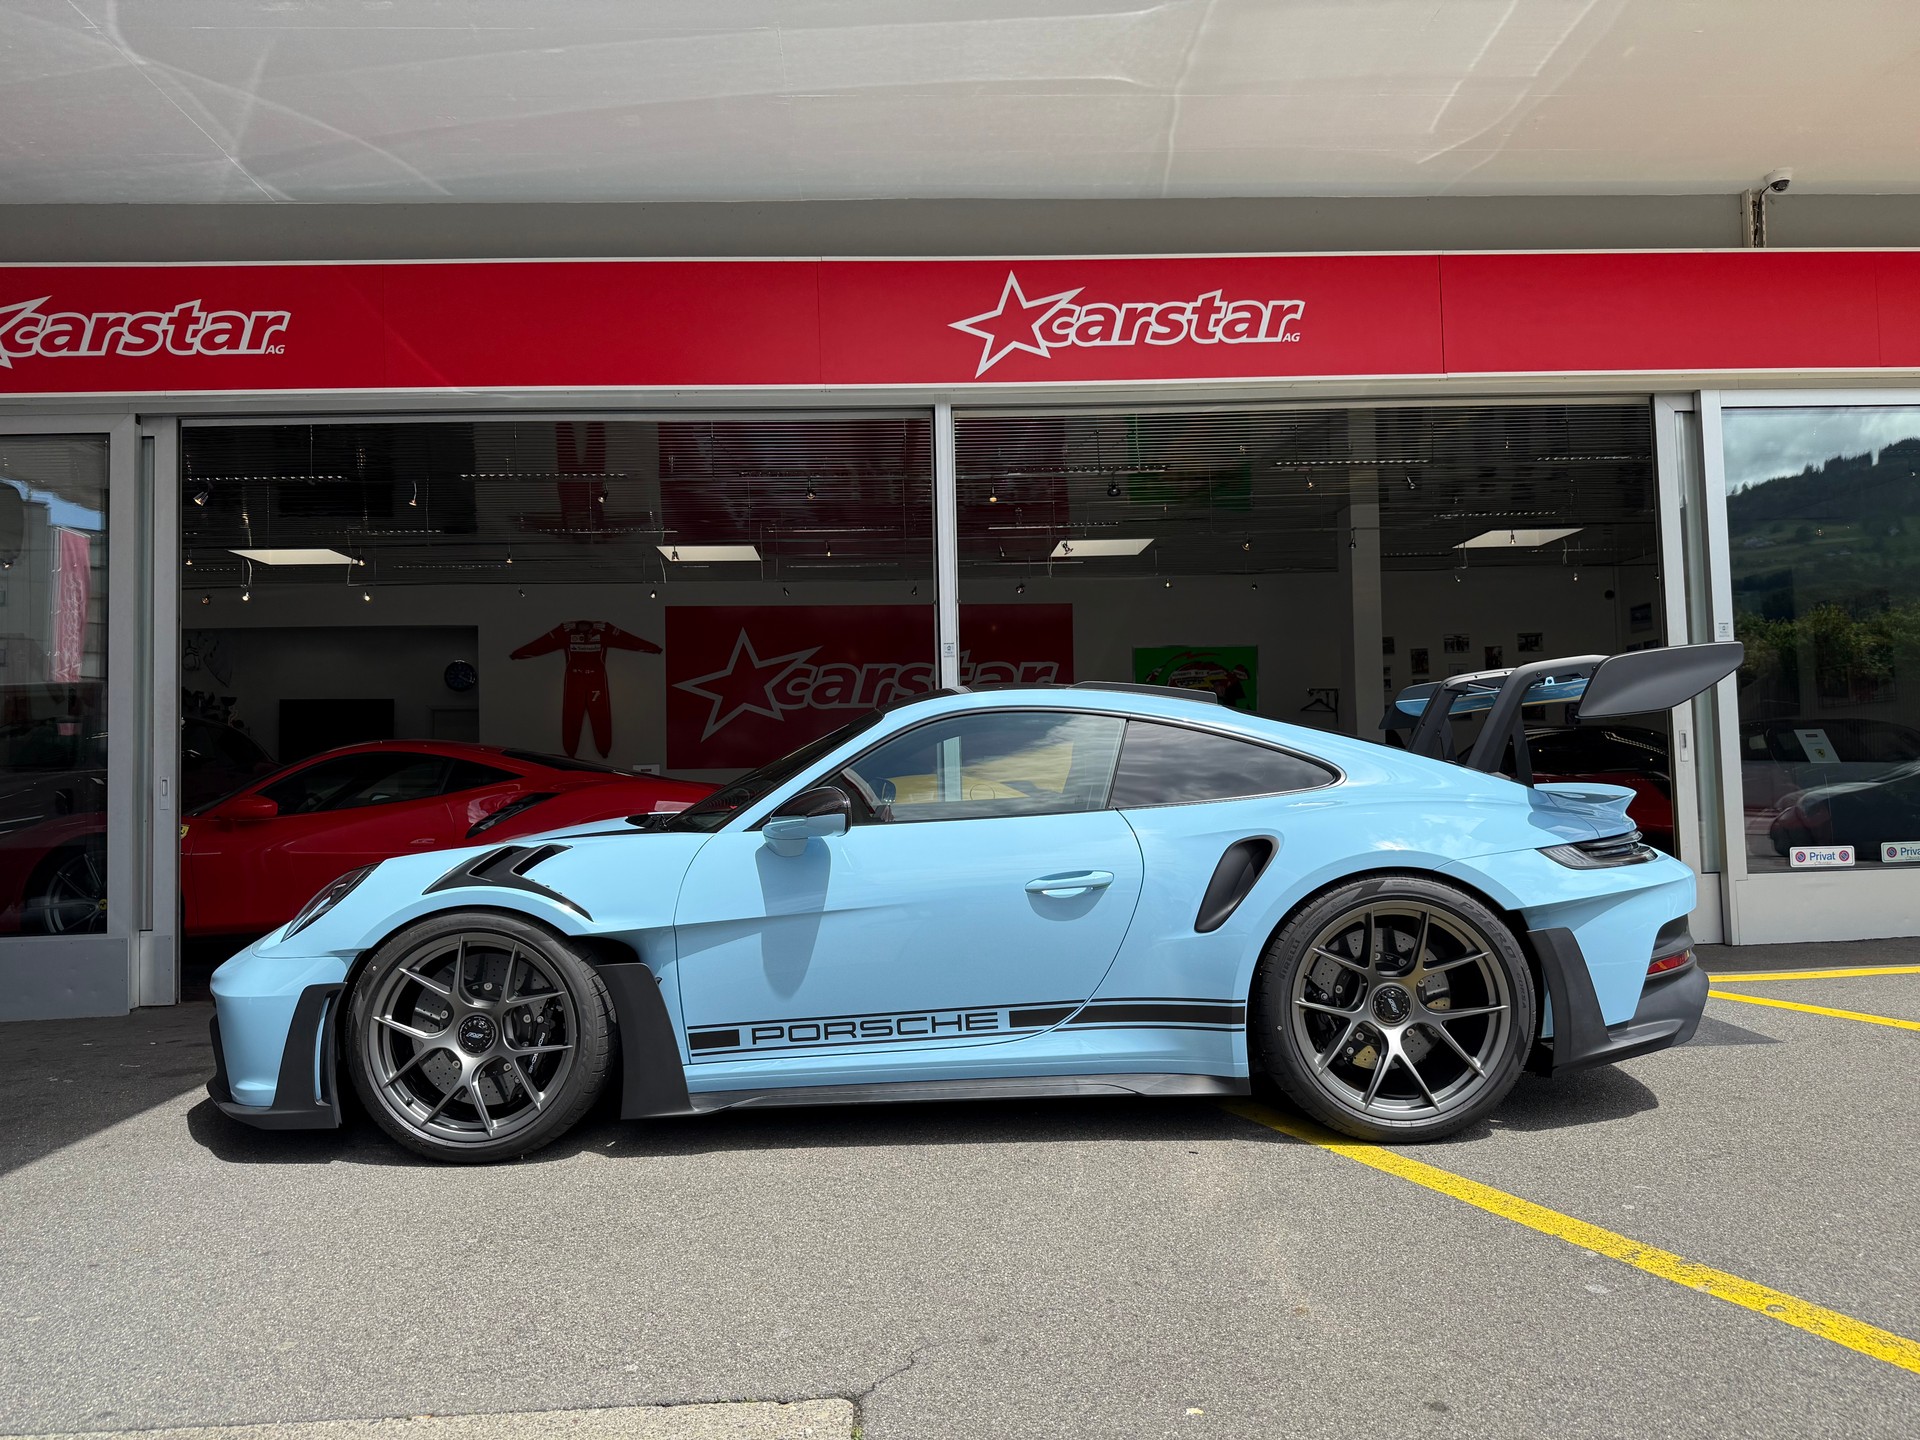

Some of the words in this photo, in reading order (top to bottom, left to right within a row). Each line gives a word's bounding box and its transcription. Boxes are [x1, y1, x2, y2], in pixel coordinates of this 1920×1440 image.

[0, 298, 291, 357] carstar
[265, 344, 286, 355] AG
[1040, 289, 1305, 347] carstar
[1281, 332, 1301, 342] AG
[591, 690, 601, 702] 7
[1809, 851, 1836, 861] Privat
[751, 1011, 999, 1046] PORSCHE
